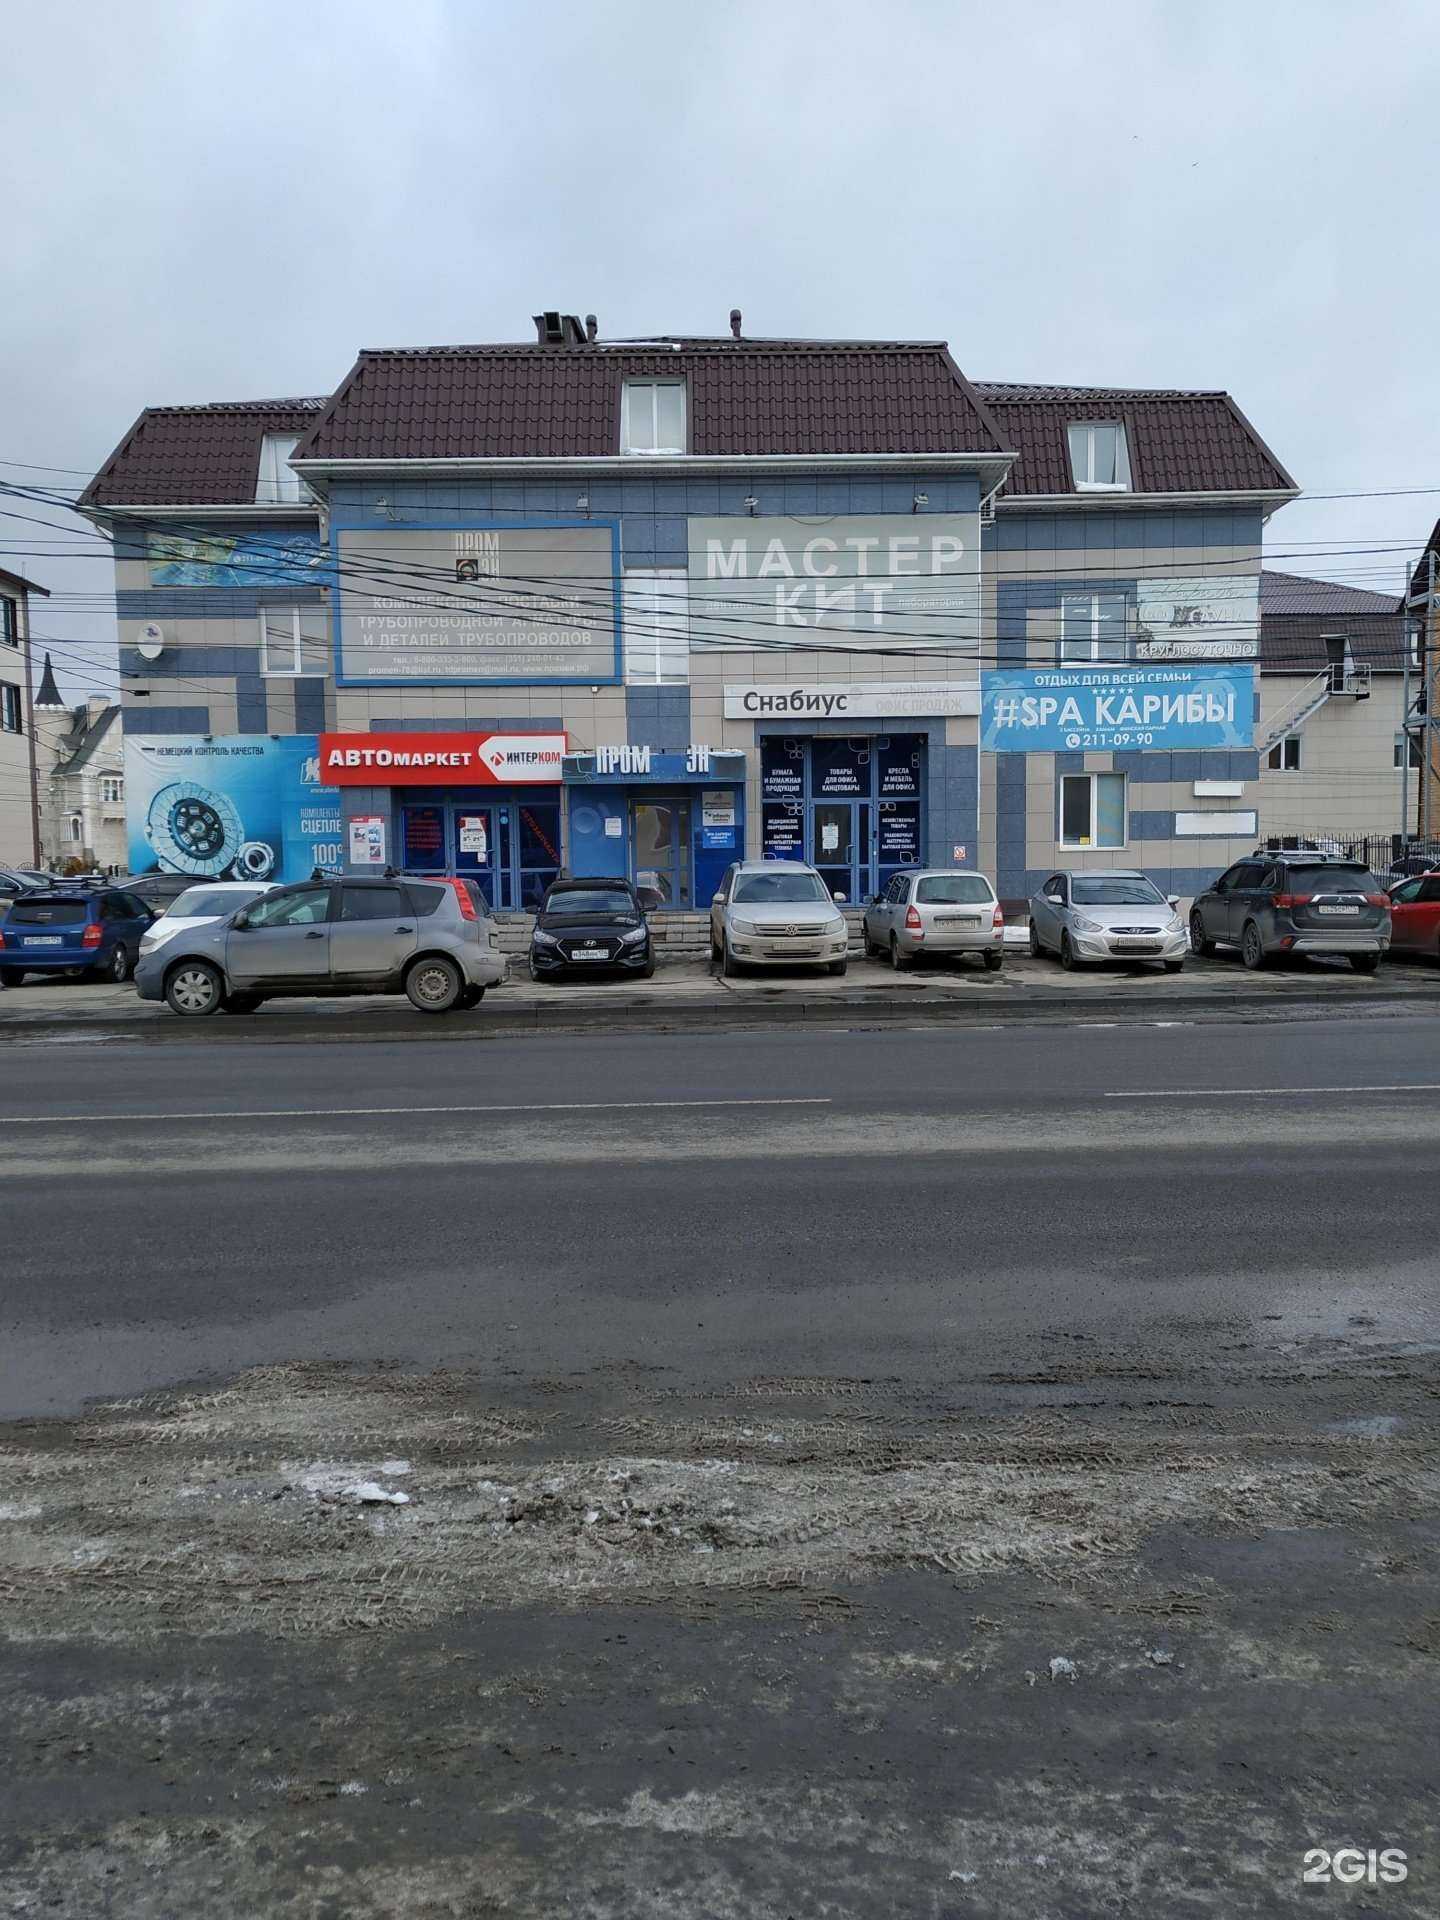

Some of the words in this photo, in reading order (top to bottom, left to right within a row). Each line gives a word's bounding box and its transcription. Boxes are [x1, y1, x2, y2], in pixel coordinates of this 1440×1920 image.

[456, 532, 499, 556] ПРОМ
[707, 536, 964, 579] МАСТЕР
[776, 583, 893, 626] КИТ
[360, 614, 504, 630] ТРУБОПРОВОДНОЙ
[364, 634, 374, 646] И
[380, 632, 449, 648] ДЕТАЛЕЙ
[458, 631, 593, 646] ТРУБОПРОВОДОВ
[1034, 674, 1080, 686] ОТДЫХ
[1082, 673, 1109, 686] ДЛЯ
[1113, 671, 1145, 685] ВСЕЙ
[1147, 672, 1192, 684] СЕМЬИ
[743, 689, 849, 716] Снабиус
[993, 696, 1085, 728] #SPA
[1095, 693, 1235, 725] КАРИБЫ
[1082, 732, 1153, 746] 211-09-90
[157, 746, 193, 756] НЕМЕЦКИЙ
[194, 746, 230, 756] КОНТРОЛЬ
[231, 745, 265, 755] КАЧЕСТВА
[506, 750, 561, 765] ИНТЕРКОМ
[596, 745, 651, 774] ПРОМ
[686, 744, 710, 773] ЭН
[771, 768, 793, 776] БУМАГА
[888, 767, 909, 775] КРЕСЛА
[769, 776, 801, 784] БУМАЖНАЯ
[824, 776, 837, 784] ДЛЯ
[889, 775, 913, 783] МЕБЕЛЬ
[822, 784, 860, 792] КАНЦТОВАРЫ
[882, 784, 895, 792] ДЛЯ
[300, 807, 341, 817] КОМПЛЕКТЫ
[301, 819, 342, 835] СЦЕПЛЕ
